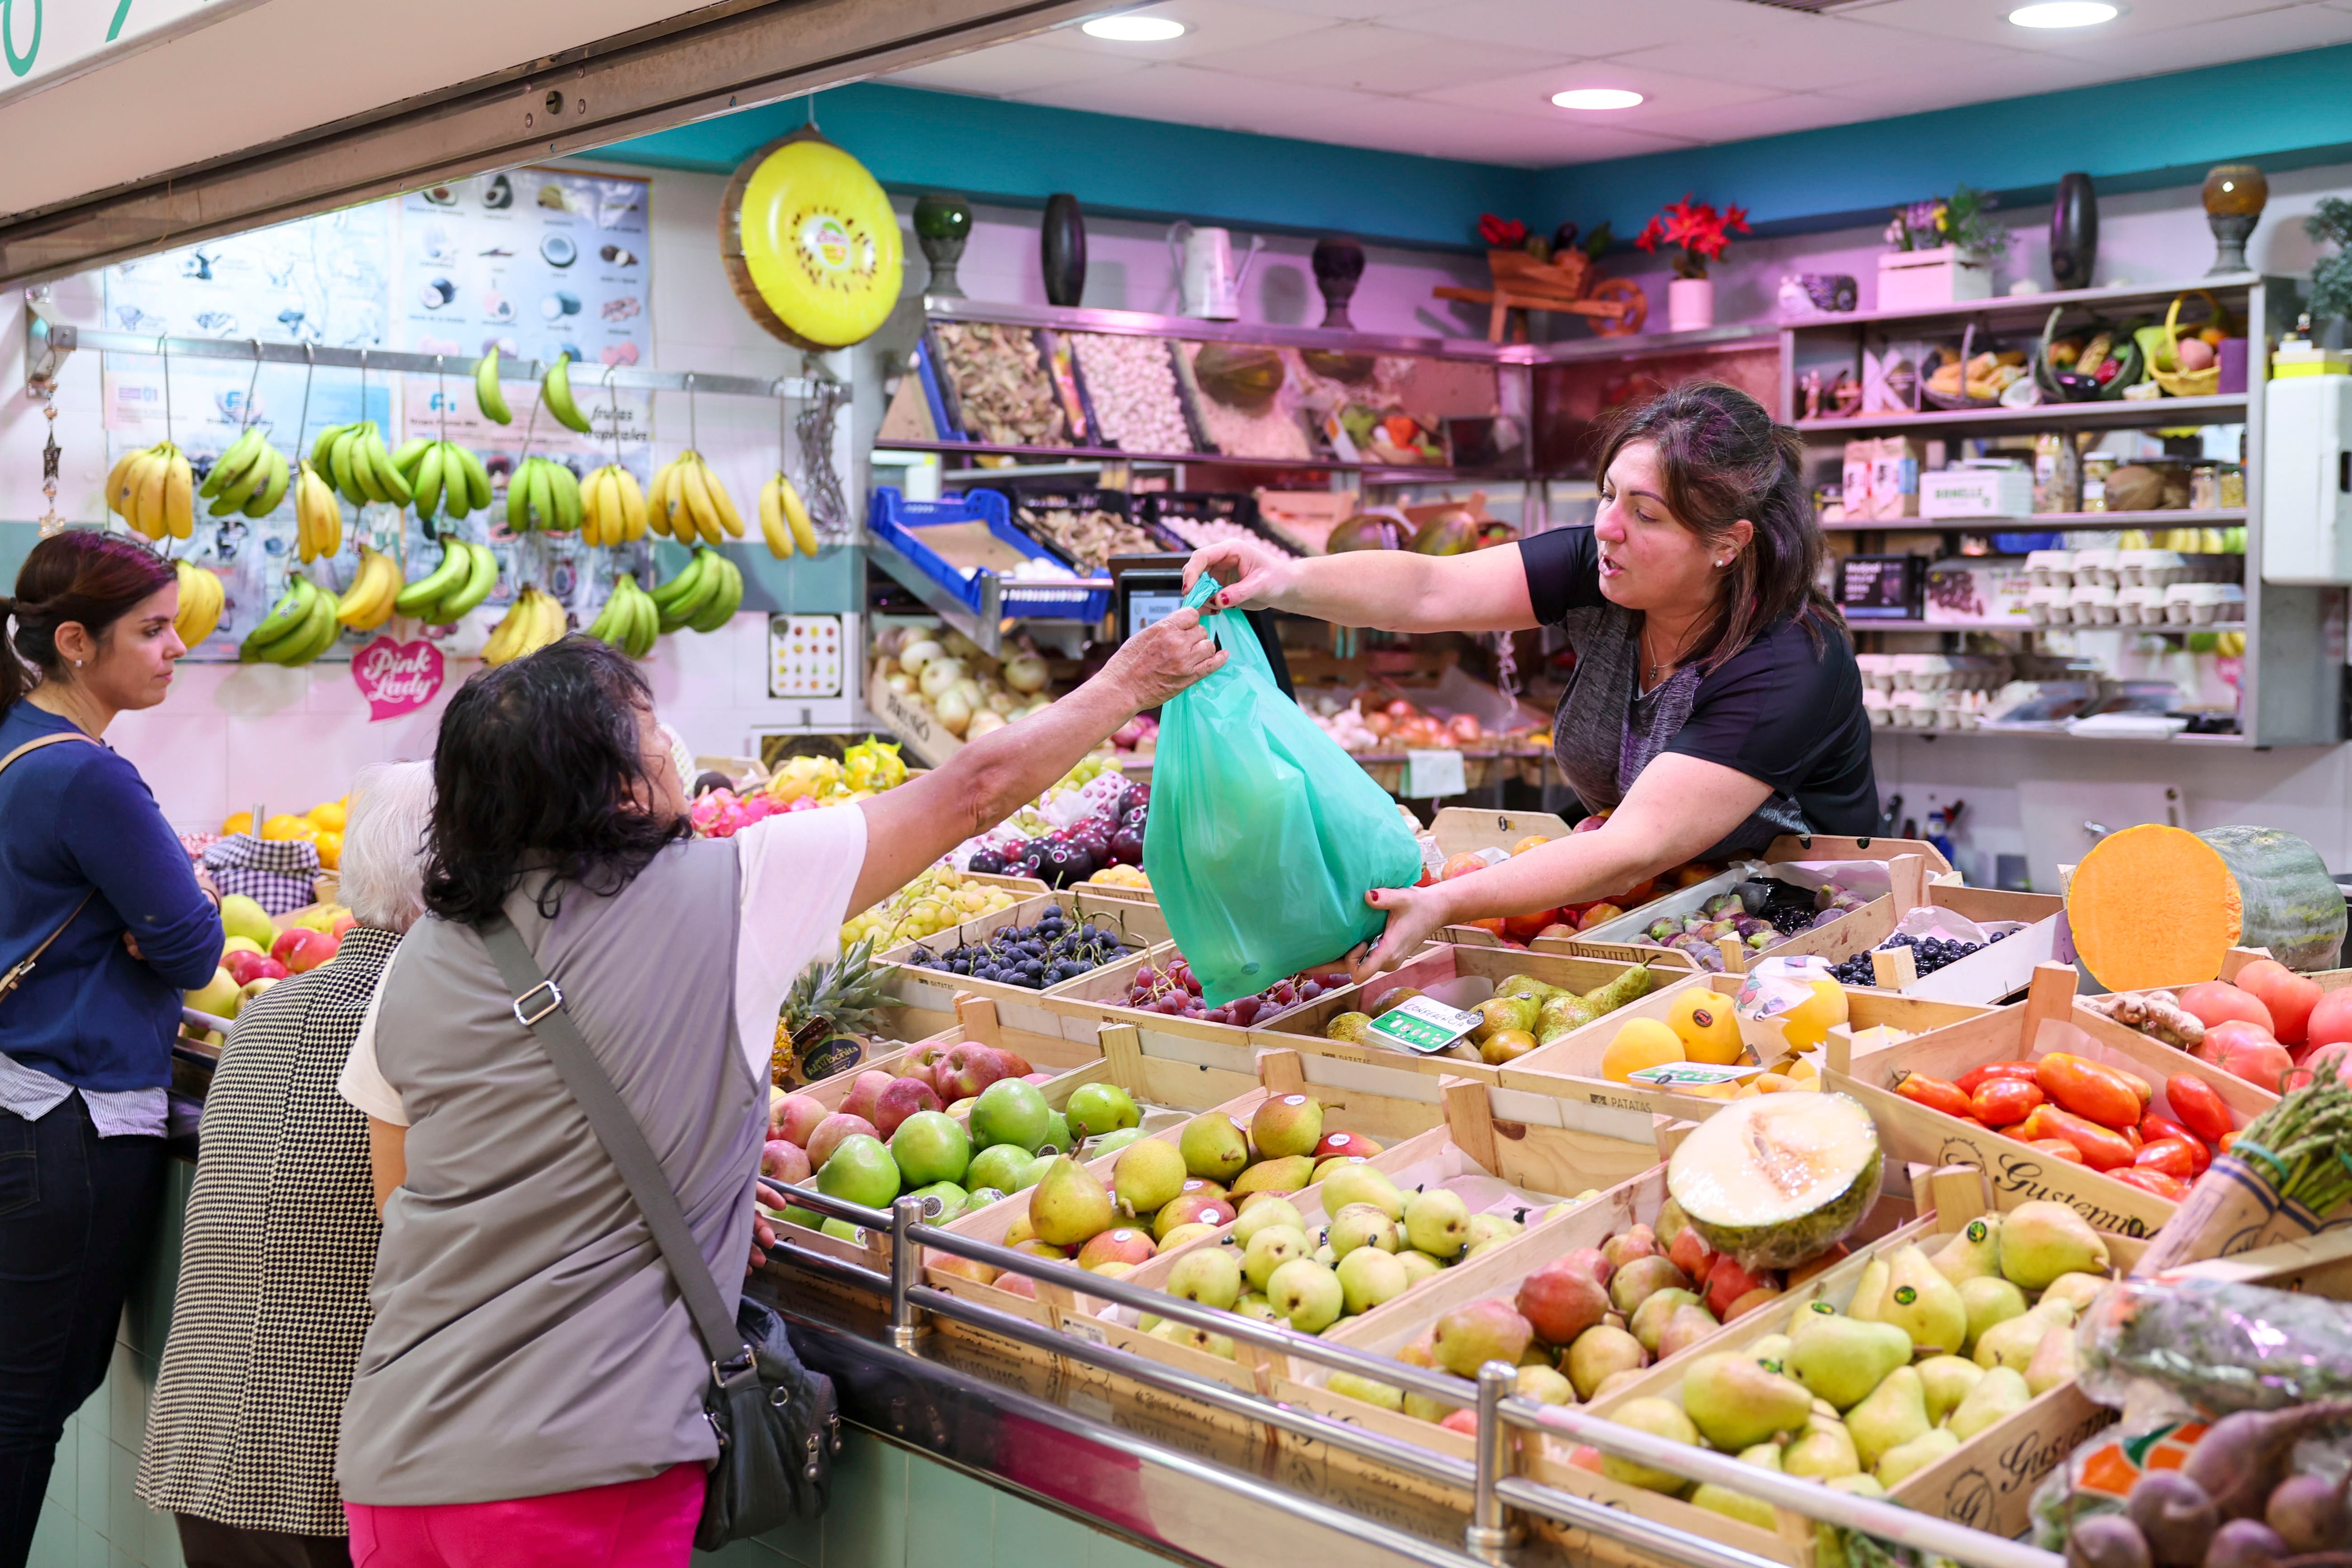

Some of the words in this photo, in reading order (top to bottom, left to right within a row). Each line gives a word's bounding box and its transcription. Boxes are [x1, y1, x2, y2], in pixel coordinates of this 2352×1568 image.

[591, 403, 633, 422] fruas
[363, 646, 432, 681] Pink
[367, 671, 434, 704] Lady
[1404, 1003, 1465, 1028] CONFERENCIA
[1611, 1097, 1653, 1114] PATATAS
